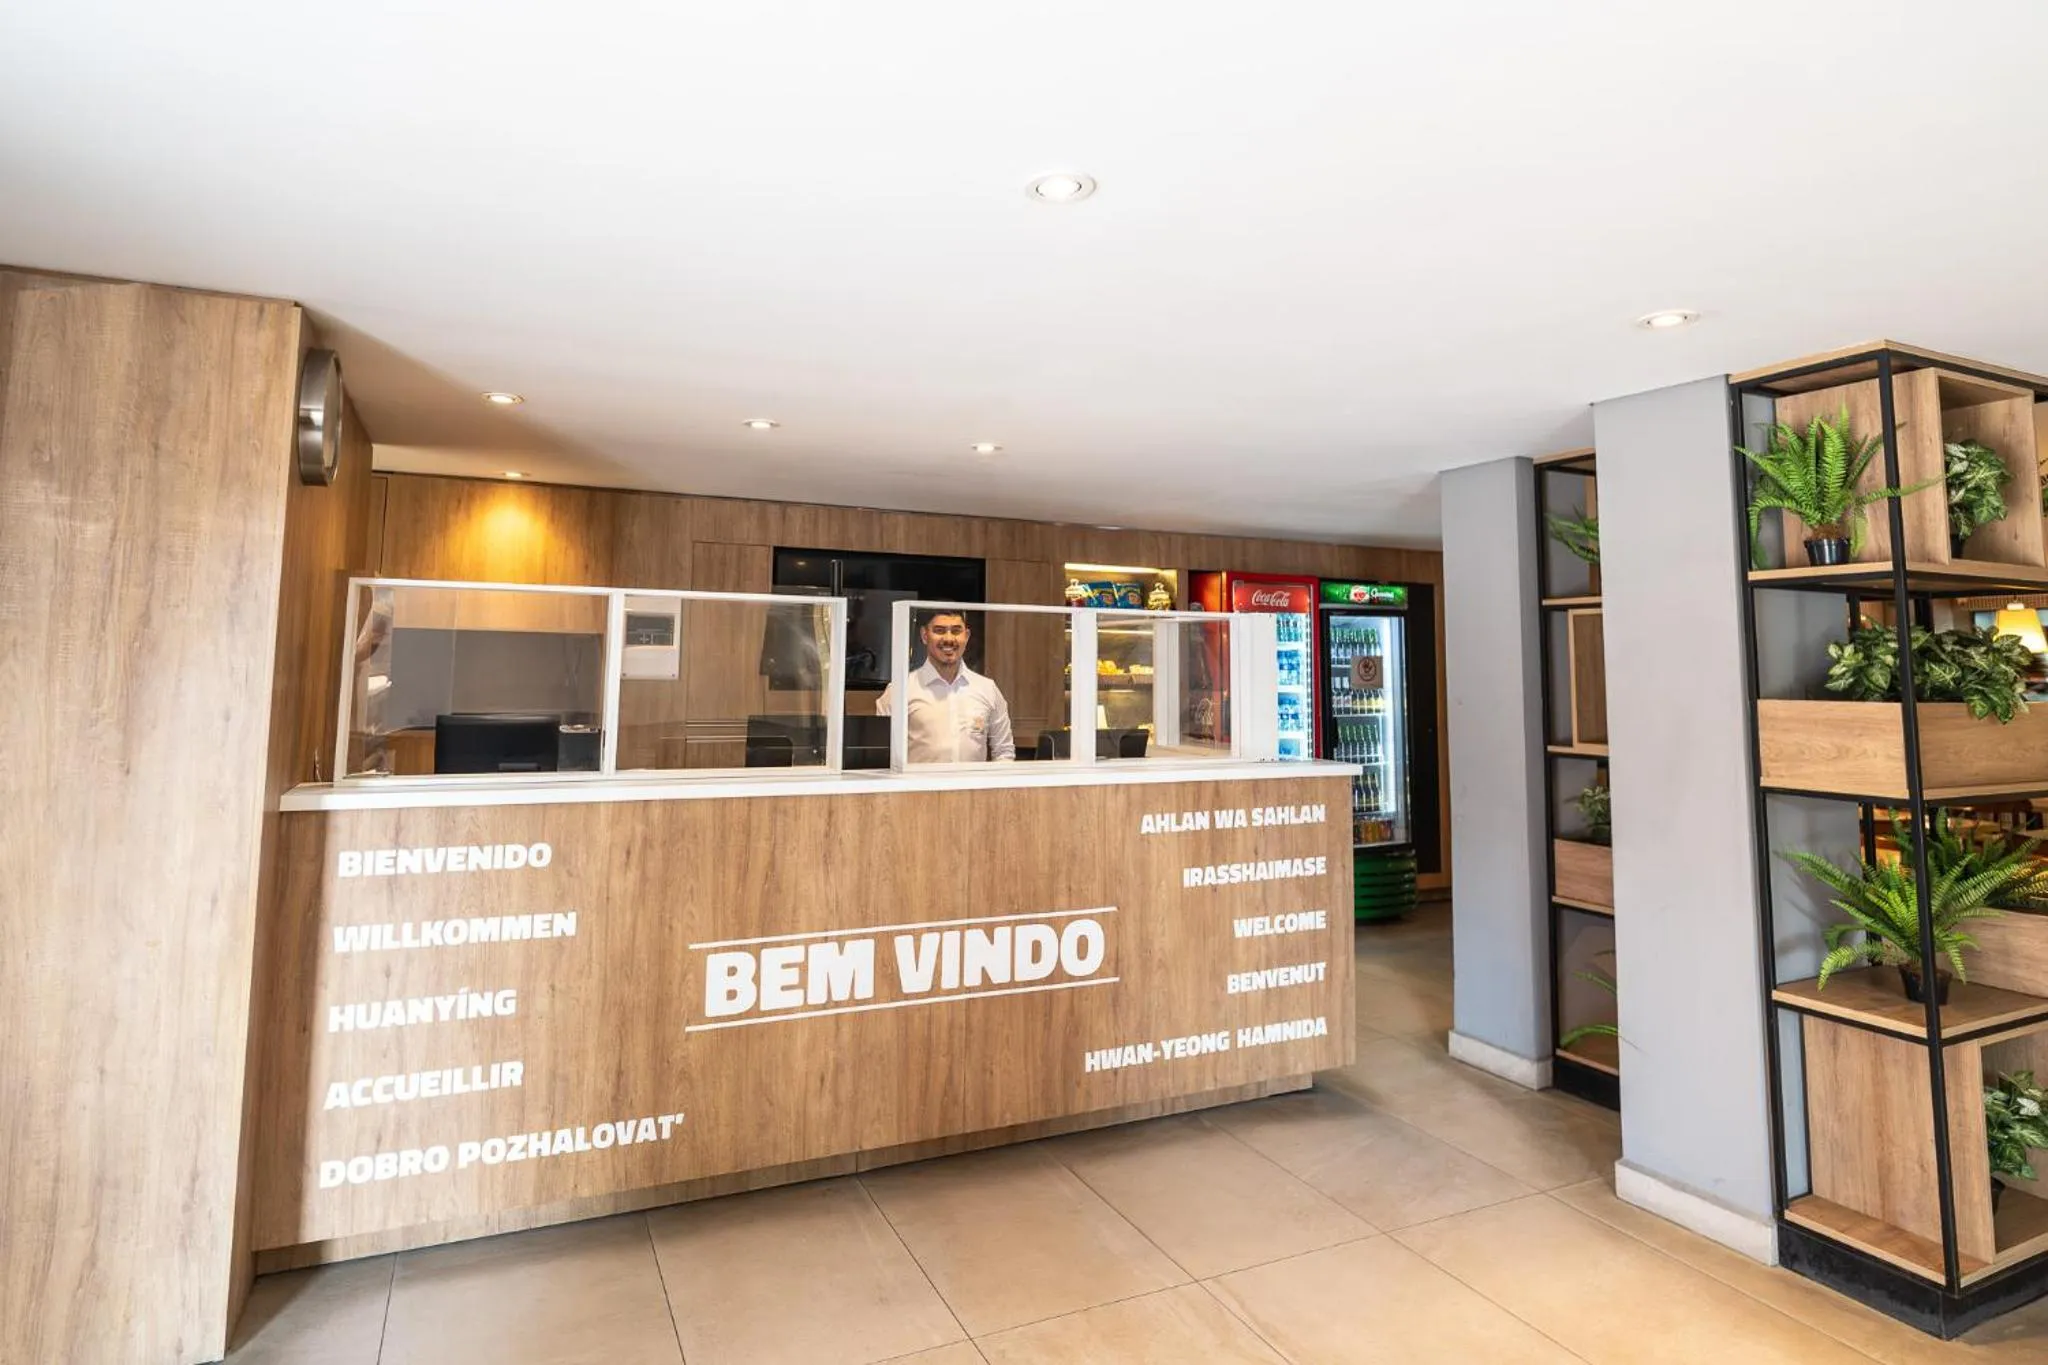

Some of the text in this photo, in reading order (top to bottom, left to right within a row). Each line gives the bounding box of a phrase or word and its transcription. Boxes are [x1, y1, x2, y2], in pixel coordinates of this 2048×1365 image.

[1141, 804, 1326, 834] AHLAN WA SAHLAN
[338, 842, 552, 878] BIENVENIDO
[1183, 856, 1327, 888] IRASSHAIMASE
[333, 911, 577, 953] WILLKOMMEN
[1233, 910, 1327, 938] WELCOME
[705, 919, 1105, 1018] BEM VINDO
[1227, 962, 1327, 994] BENVENUT
[328, 987, 517, 1034] HUANYÍNG
[1085, 1017, 1328, 1073] HWAN-YEONG HAMNIDA
[323, 1061, 524, 1111] ACCUEILLIR
[319, 1144, 450, 1189] DOBRO
